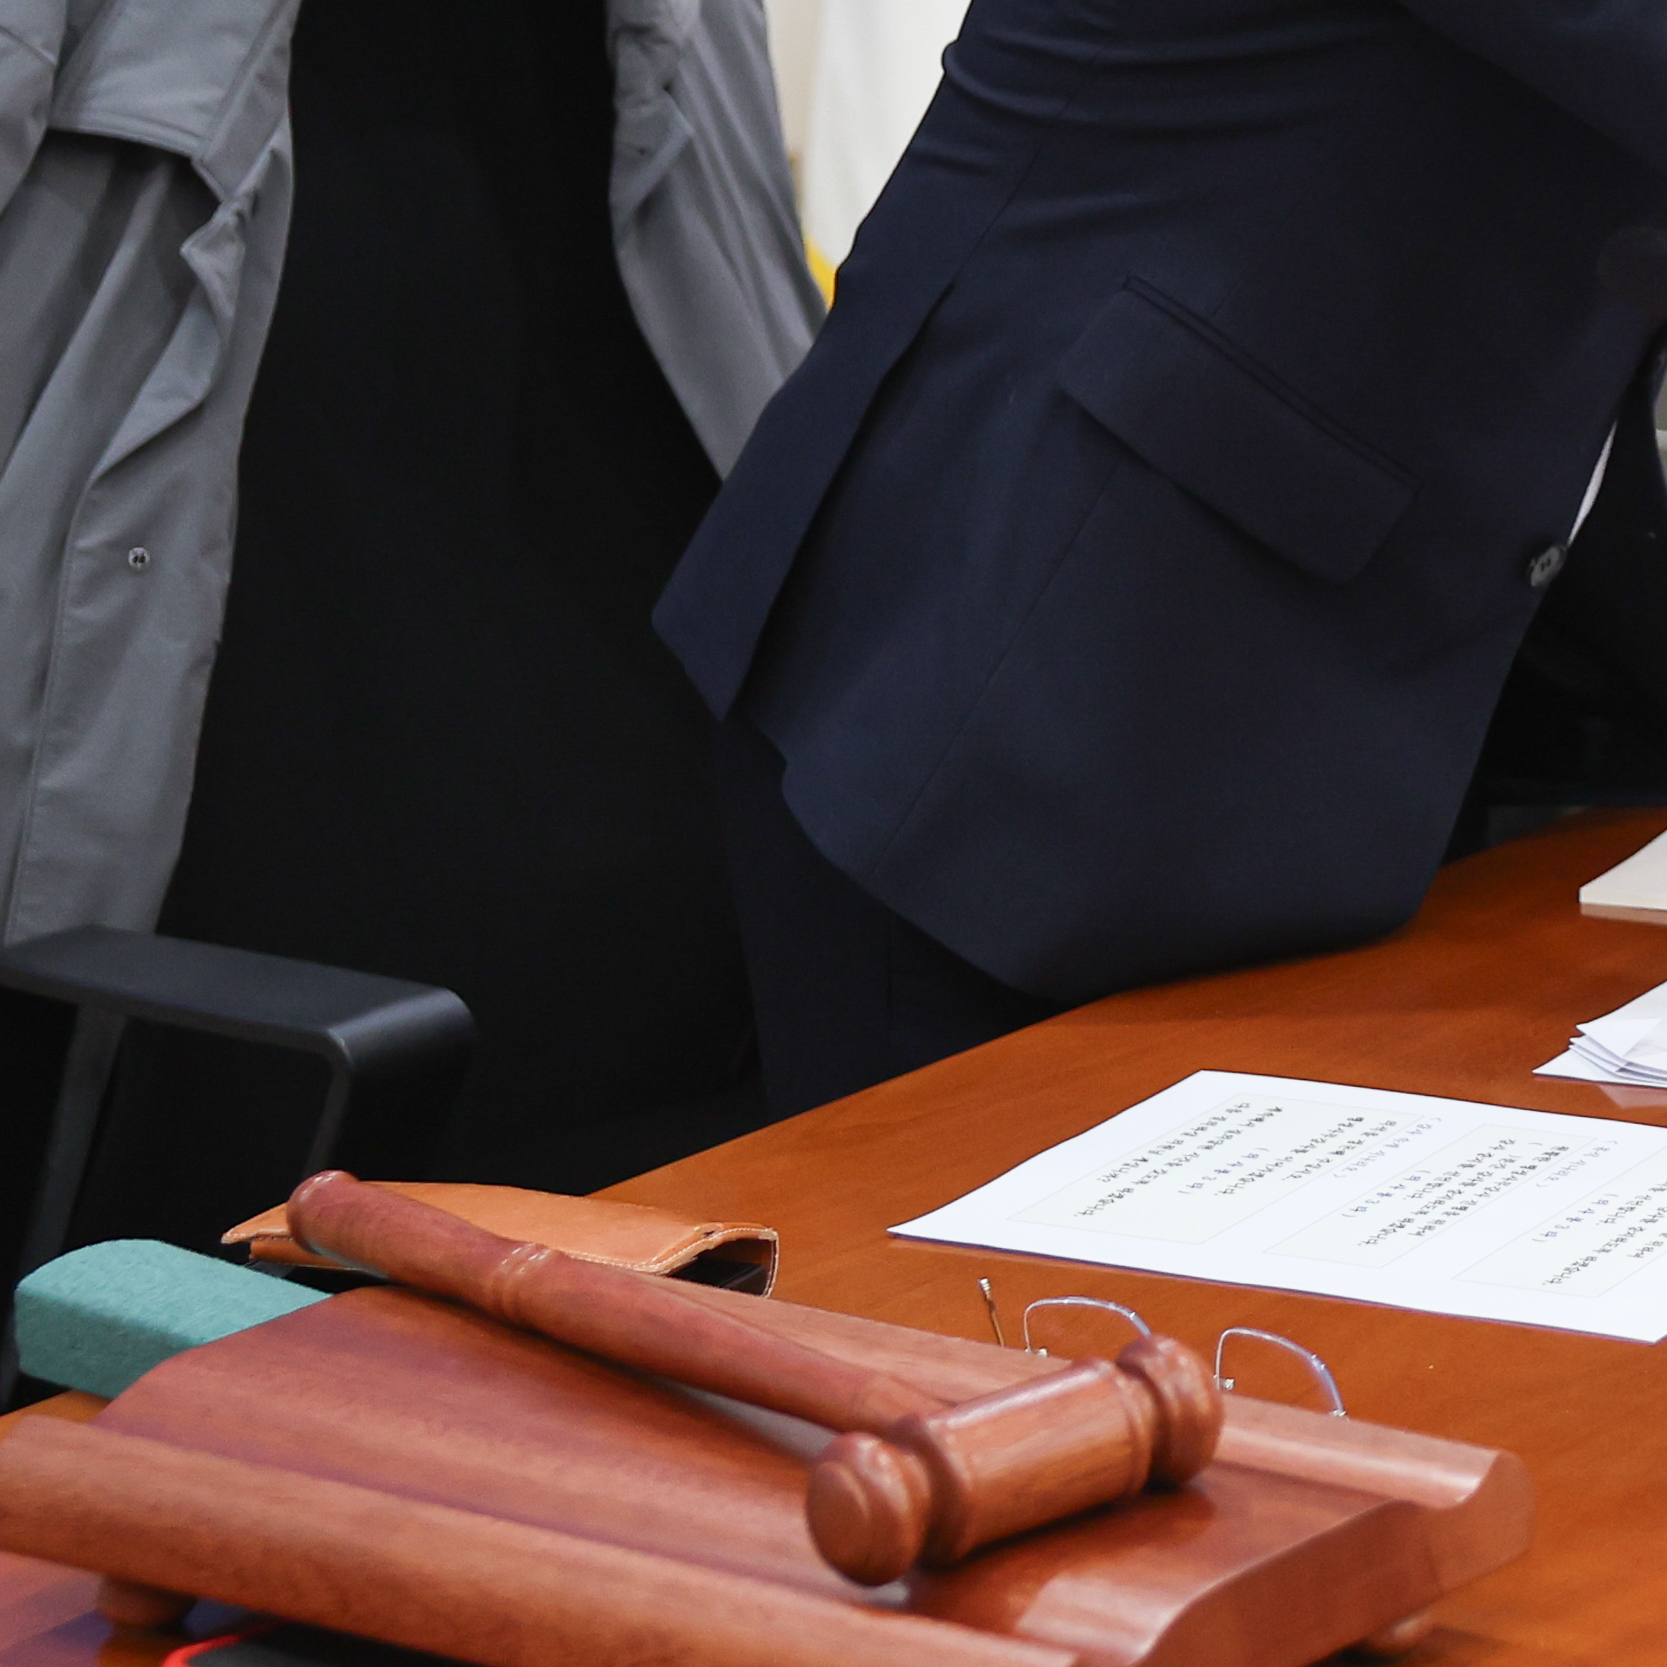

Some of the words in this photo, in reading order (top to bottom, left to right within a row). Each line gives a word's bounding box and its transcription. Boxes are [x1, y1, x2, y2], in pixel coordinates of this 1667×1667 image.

[1489, 1138, 1516, 1151] 감사
[1457, 1152, 1495, 1169] 중지를
[1402, 1170, 1461, 1200] 선언합니다.
[1458, 1170, 1494, 1188] 감사를
[1074, 1187, 1134, 1217] 하겠습니다.
[1411, 1188, 1465, 1216] 중지하도록
[1596, 1194, 1651, 1226] 선언합니다.
[1358, 1217, 1415, 1246] 하겠습니다.
[1592, 1226, 1646, 1254] 중지하도록
[1542, 1255, 1598, 1285] 하겠습니다.
